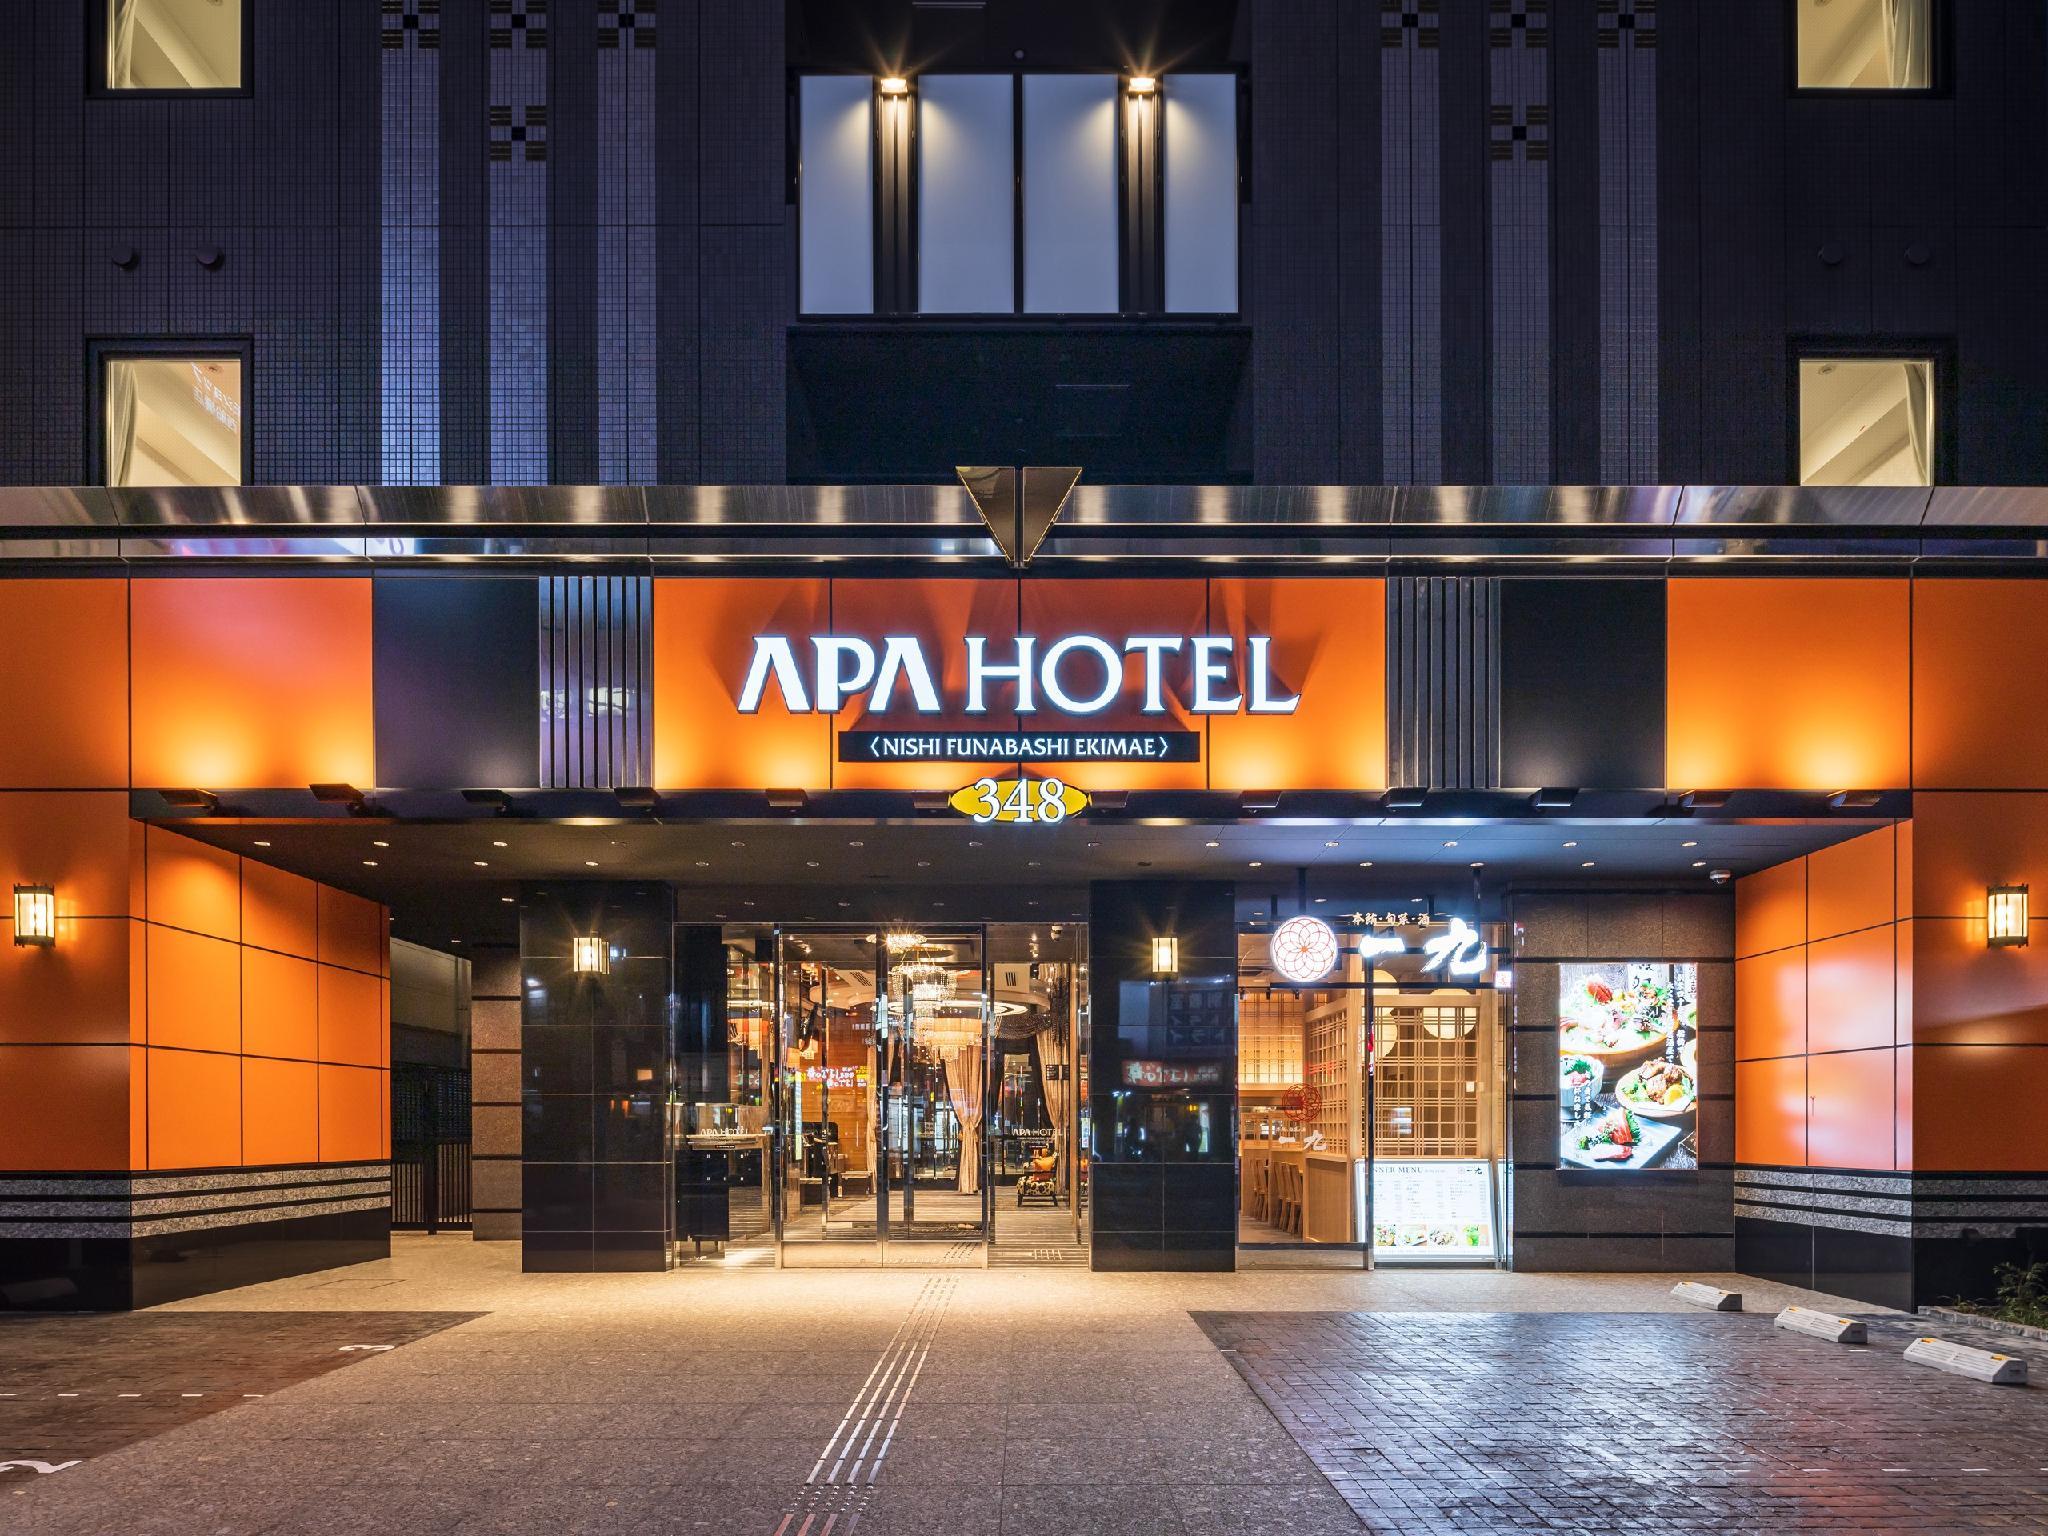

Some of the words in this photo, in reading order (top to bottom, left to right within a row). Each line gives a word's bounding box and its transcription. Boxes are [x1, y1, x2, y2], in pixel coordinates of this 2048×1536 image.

[737, 635, 942, 714] APA
[963, 634, 1302, 714] HOTEL
[947, 737, 1068, 756] FUNABASHI
[973, 778, 1067, 824] 348
